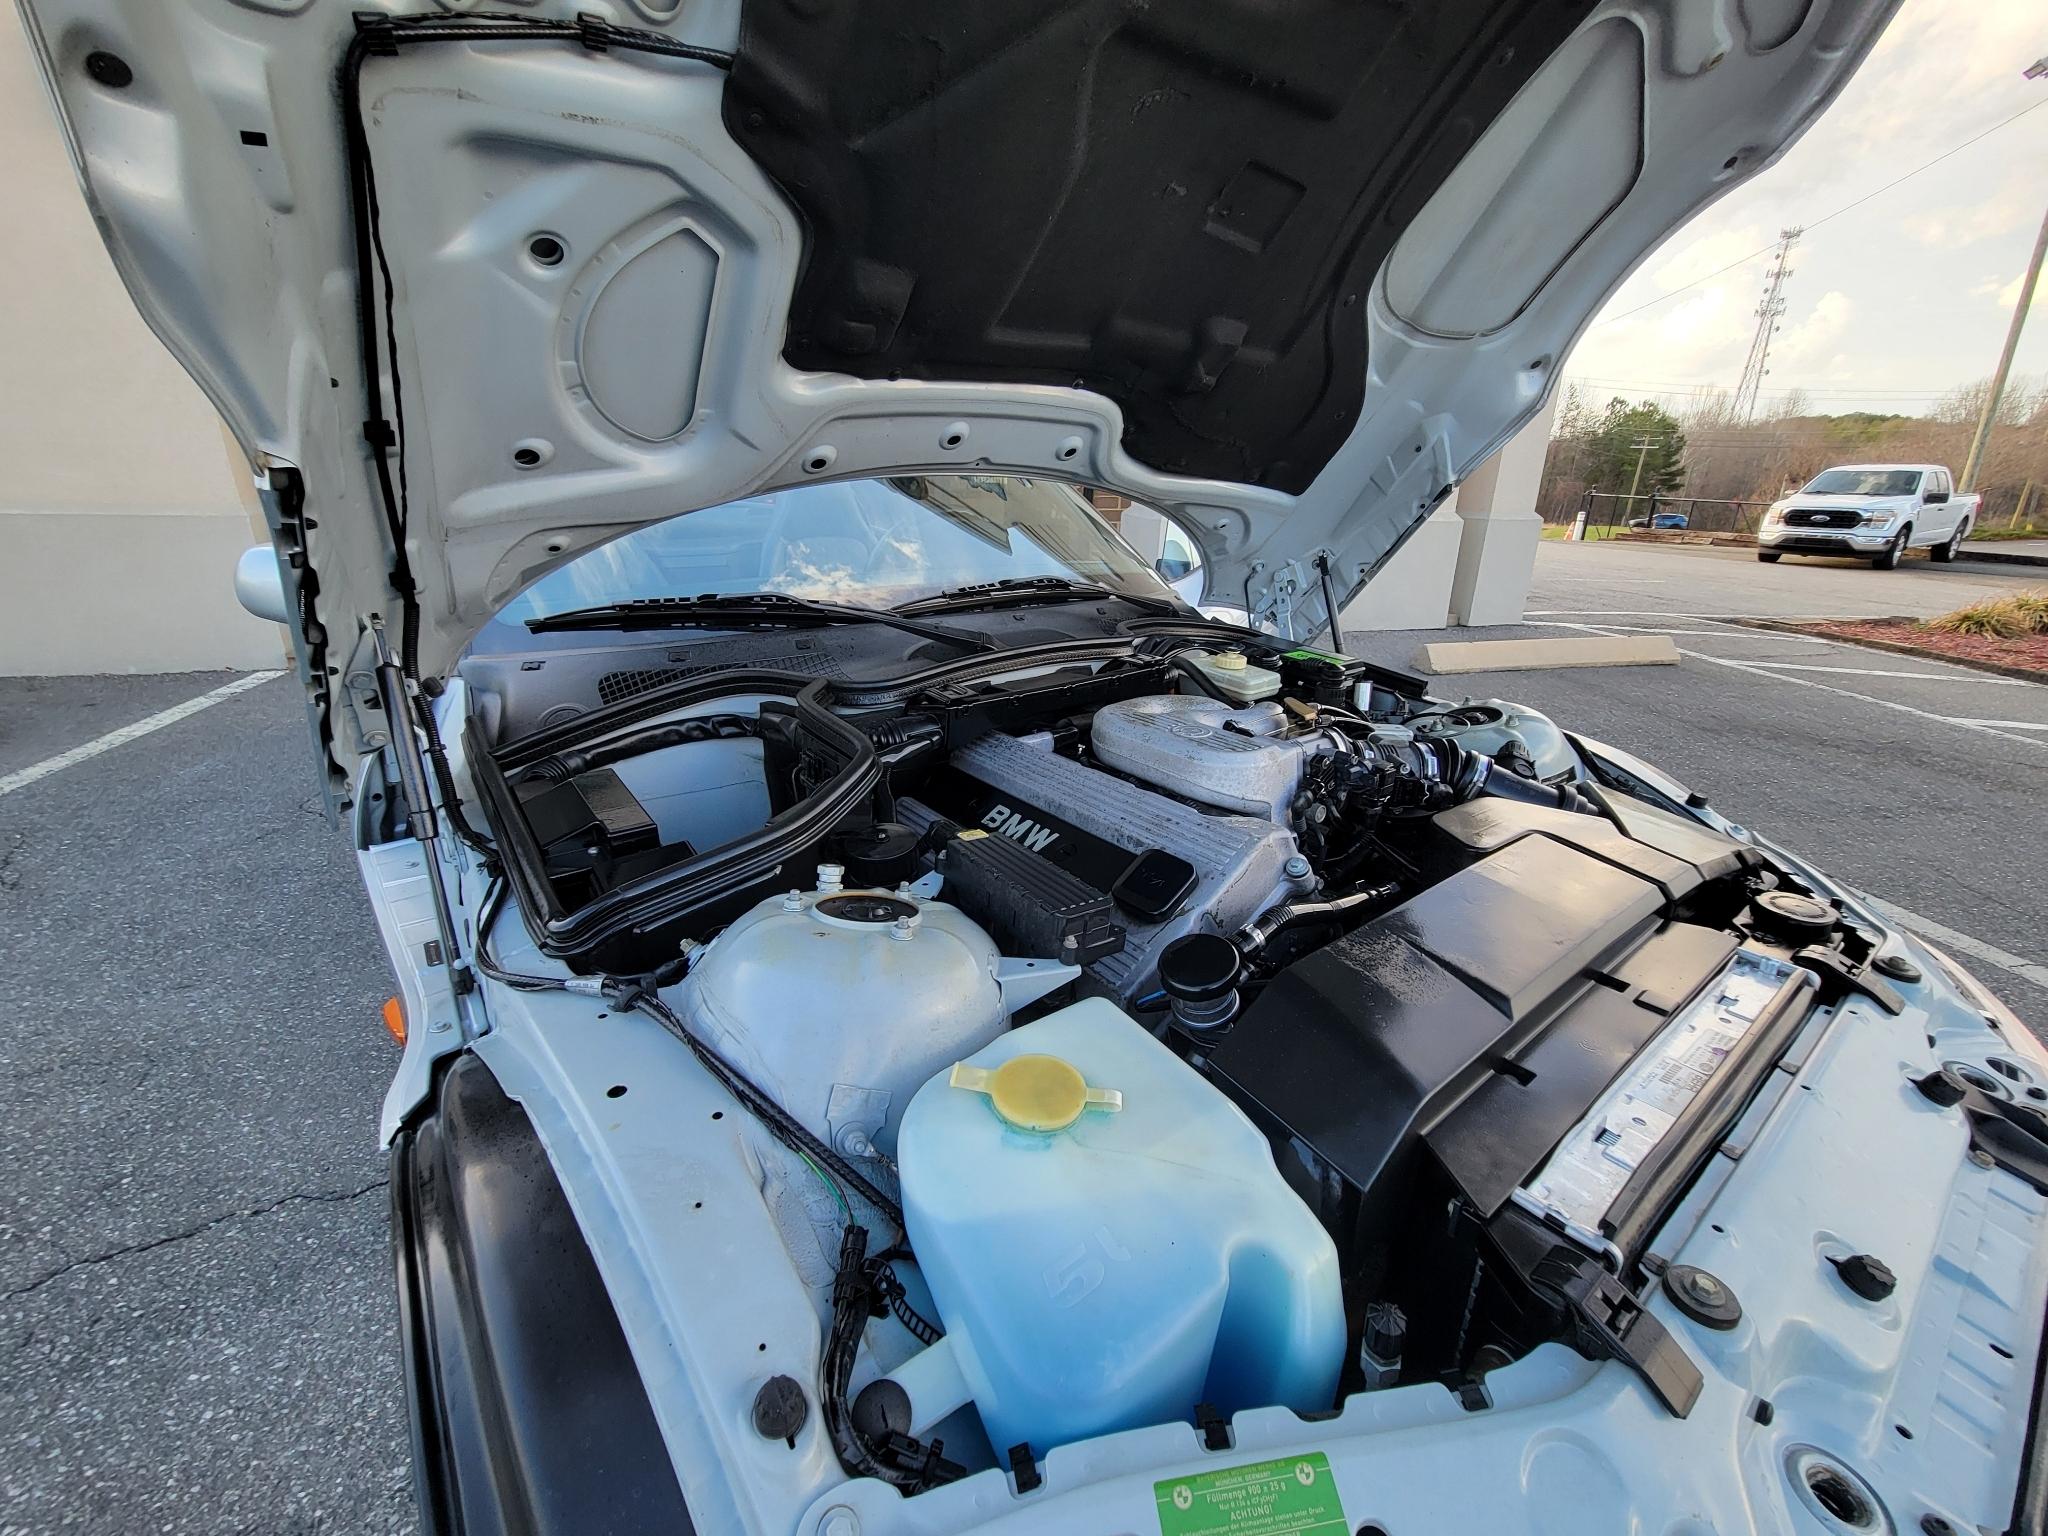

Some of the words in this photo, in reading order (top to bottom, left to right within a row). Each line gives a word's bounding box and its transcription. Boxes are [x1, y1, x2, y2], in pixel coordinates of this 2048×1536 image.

[981, 804, 1060, 852] BMW
[1206, 1488, 1246, 1504] Füllmenge
[1247, 1485, 1261, 1495] 900
[1269, 1481, 1280, 1491] 25
[1229, 1504, 1273, 1521] ACHTUNG!
